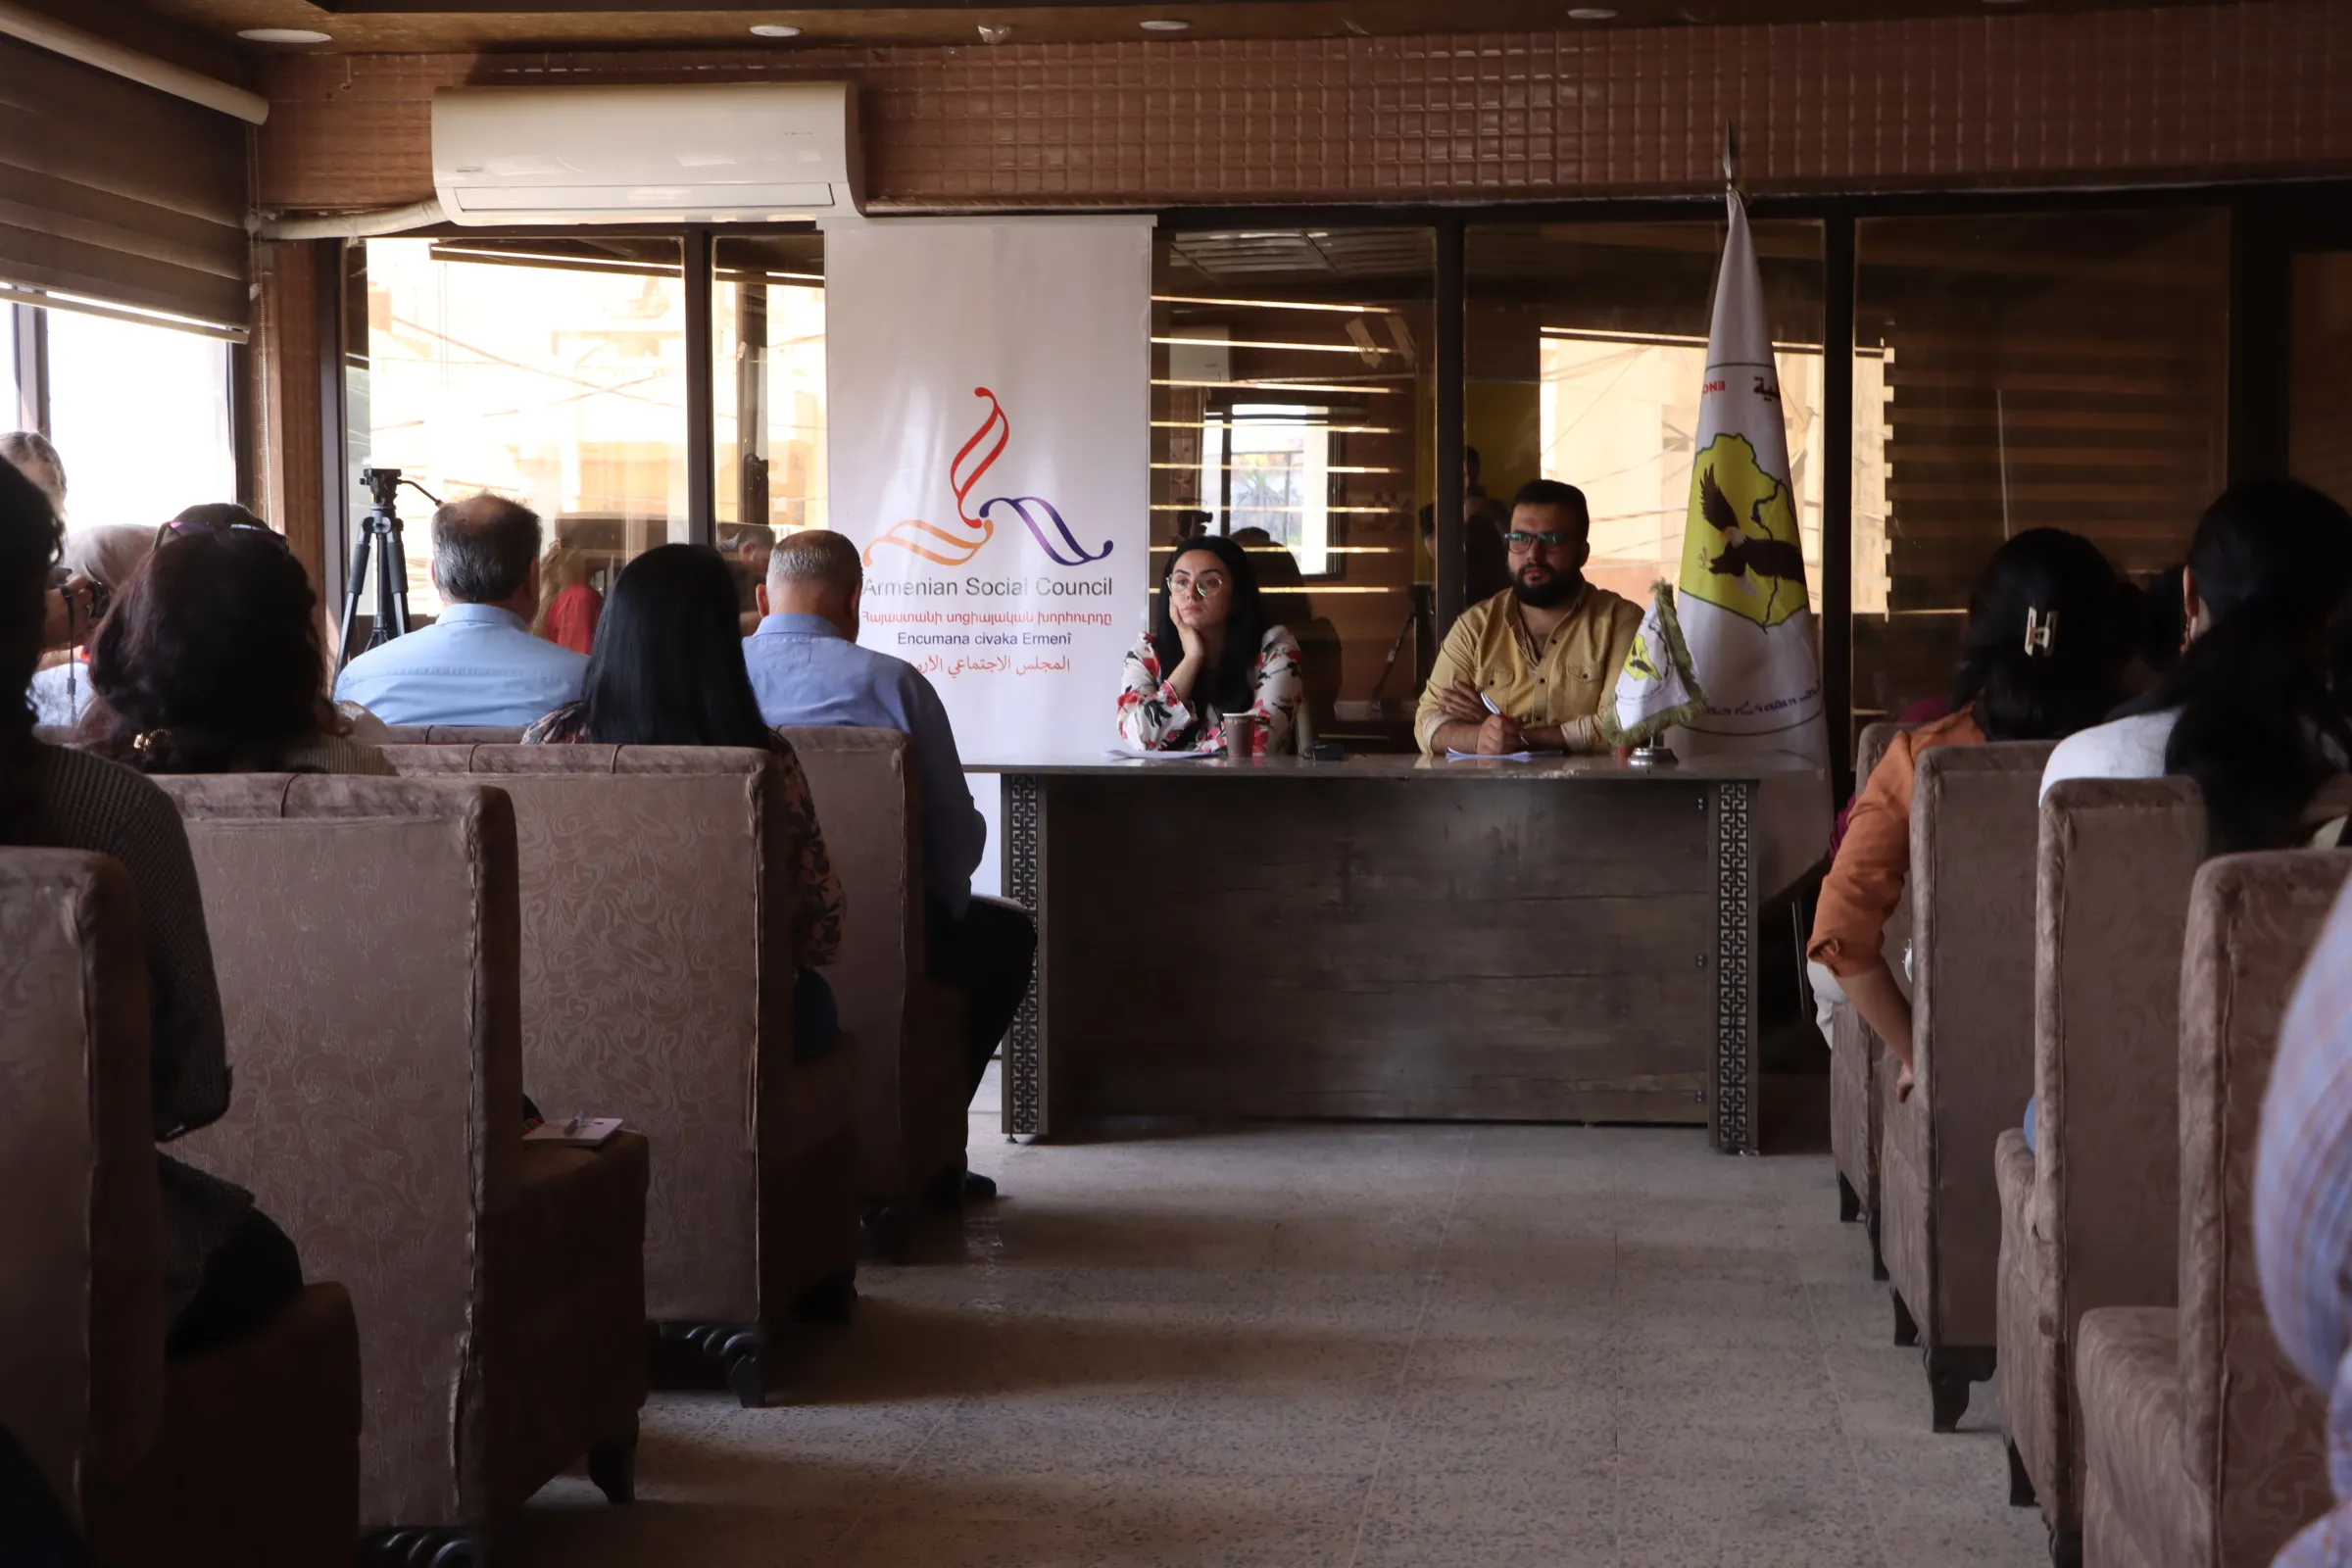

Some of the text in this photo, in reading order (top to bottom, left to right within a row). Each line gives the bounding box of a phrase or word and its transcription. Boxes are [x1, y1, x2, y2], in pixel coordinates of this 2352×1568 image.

[862, 576, 1112, 596] Armenian Social Council
[898, 632, 970, 645] Encumana
[974, 631, 1018, 645] civaka
[947, 654, 1011, 679] الاجتماعي
[1015, 654, 1071, 676] المجلس
